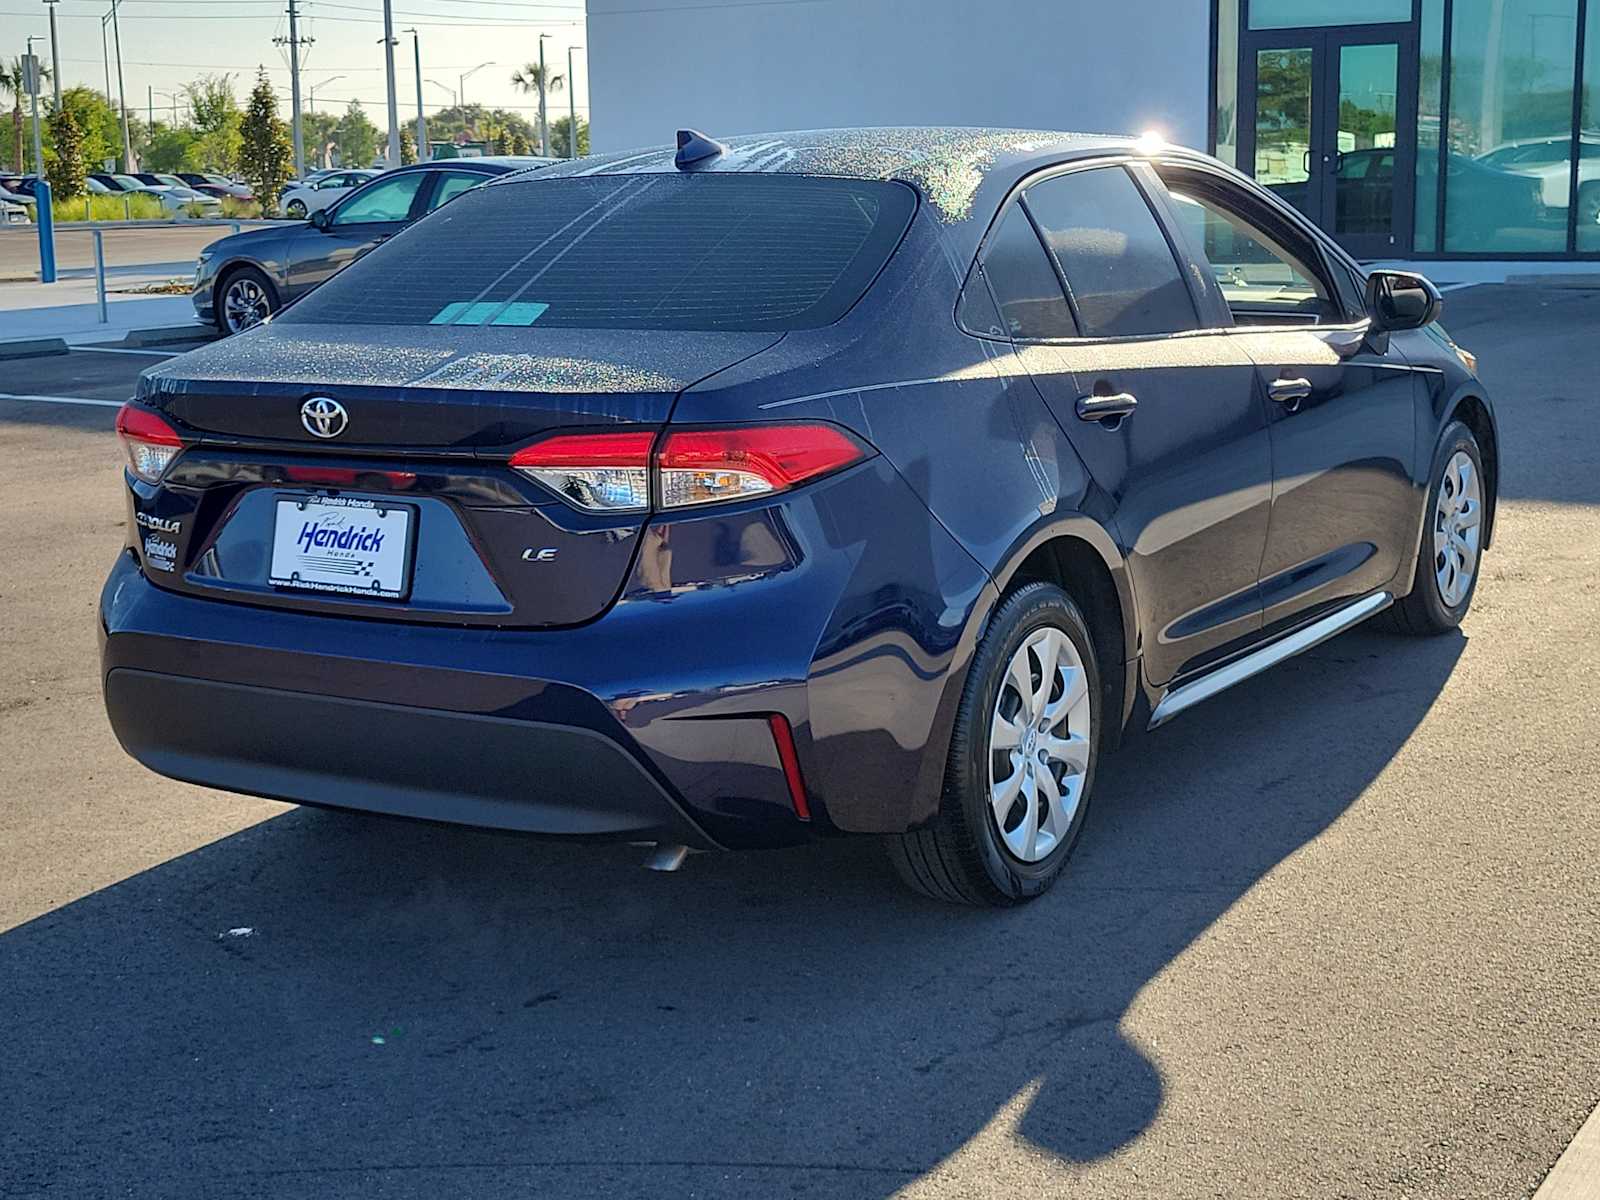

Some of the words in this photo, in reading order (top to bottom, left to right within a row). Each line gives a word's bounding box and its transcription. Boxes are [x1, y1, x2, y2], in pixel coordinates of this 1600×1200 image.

[347, 499, 375, 509] Honda
[297, 521, 385, 553] Hendrick
[521, 548, 558, 561] LE
